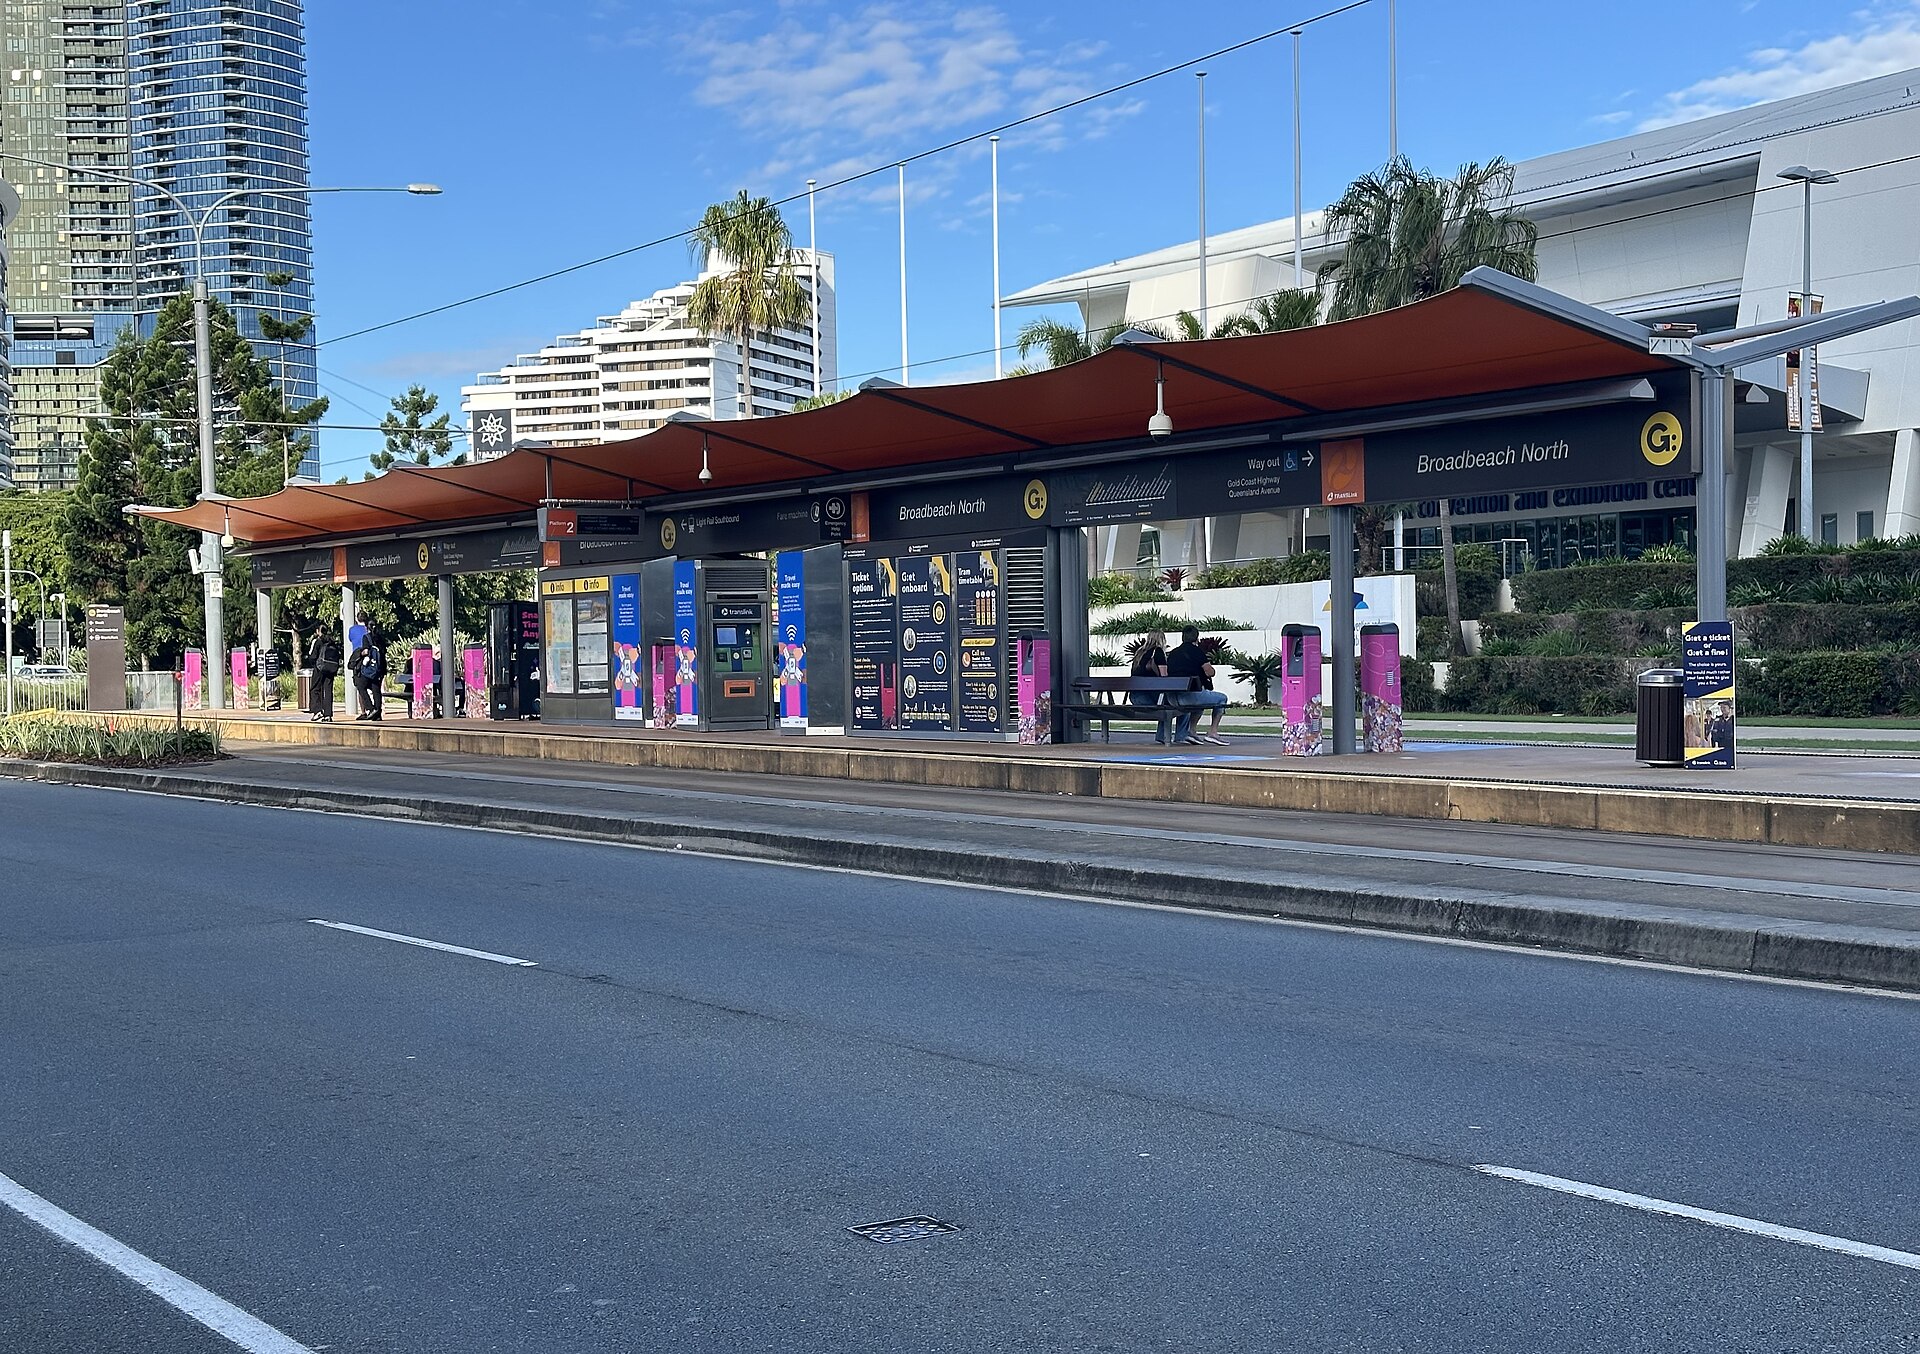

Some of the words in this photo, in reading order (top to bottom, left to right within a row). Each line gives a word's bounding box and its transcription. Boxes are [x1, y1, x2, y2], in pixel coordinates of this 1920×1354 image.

[1811, 389, 1820, 423] GALA
[1417, 446, 1515, 473] Broadbeach
[1521, 440, 1569, 462] North
[1248, 459, 1265, 471] Way
[1268, 457, 1280, 467] out
[1227, 479, 1240, 488] Gold
[1241, 478, 1257, 486] Coast
[1257, 477, 1280, 486] Highway
[1228, 489, 1259, 498] Queensland
[1261, 487, 1280, 495] Avenue
[1514, 491, 1548, 511] and
[788, 511, 808, 519] machine
[899, 502, 956, 521] Broadbeach
[958, 498, 986, 514] North
[696, 518, 706, 527] Light
[715, 514, 740, 524] Southbound
[567, 522, 574, 533] 2
[360, 555, 387, 568] Broadbeach
[388, 554, 401, 564] North
[852, 572, 870, 582] Ticket
[902, 572, 916, 582] G:et
[958, 568, 970, 576] Tram
[589, 579, 599, 589] info
[958, 575, 982, 584] timetable
[555, 582, 564, 591] info
[853, 583, 874, 594] options
[902, 581, 928, 593] onboard
[522, 611, 539, 619] Sna
[522, 631, 540, 639] Any
[1711, 648, 1728, 656] fine!
